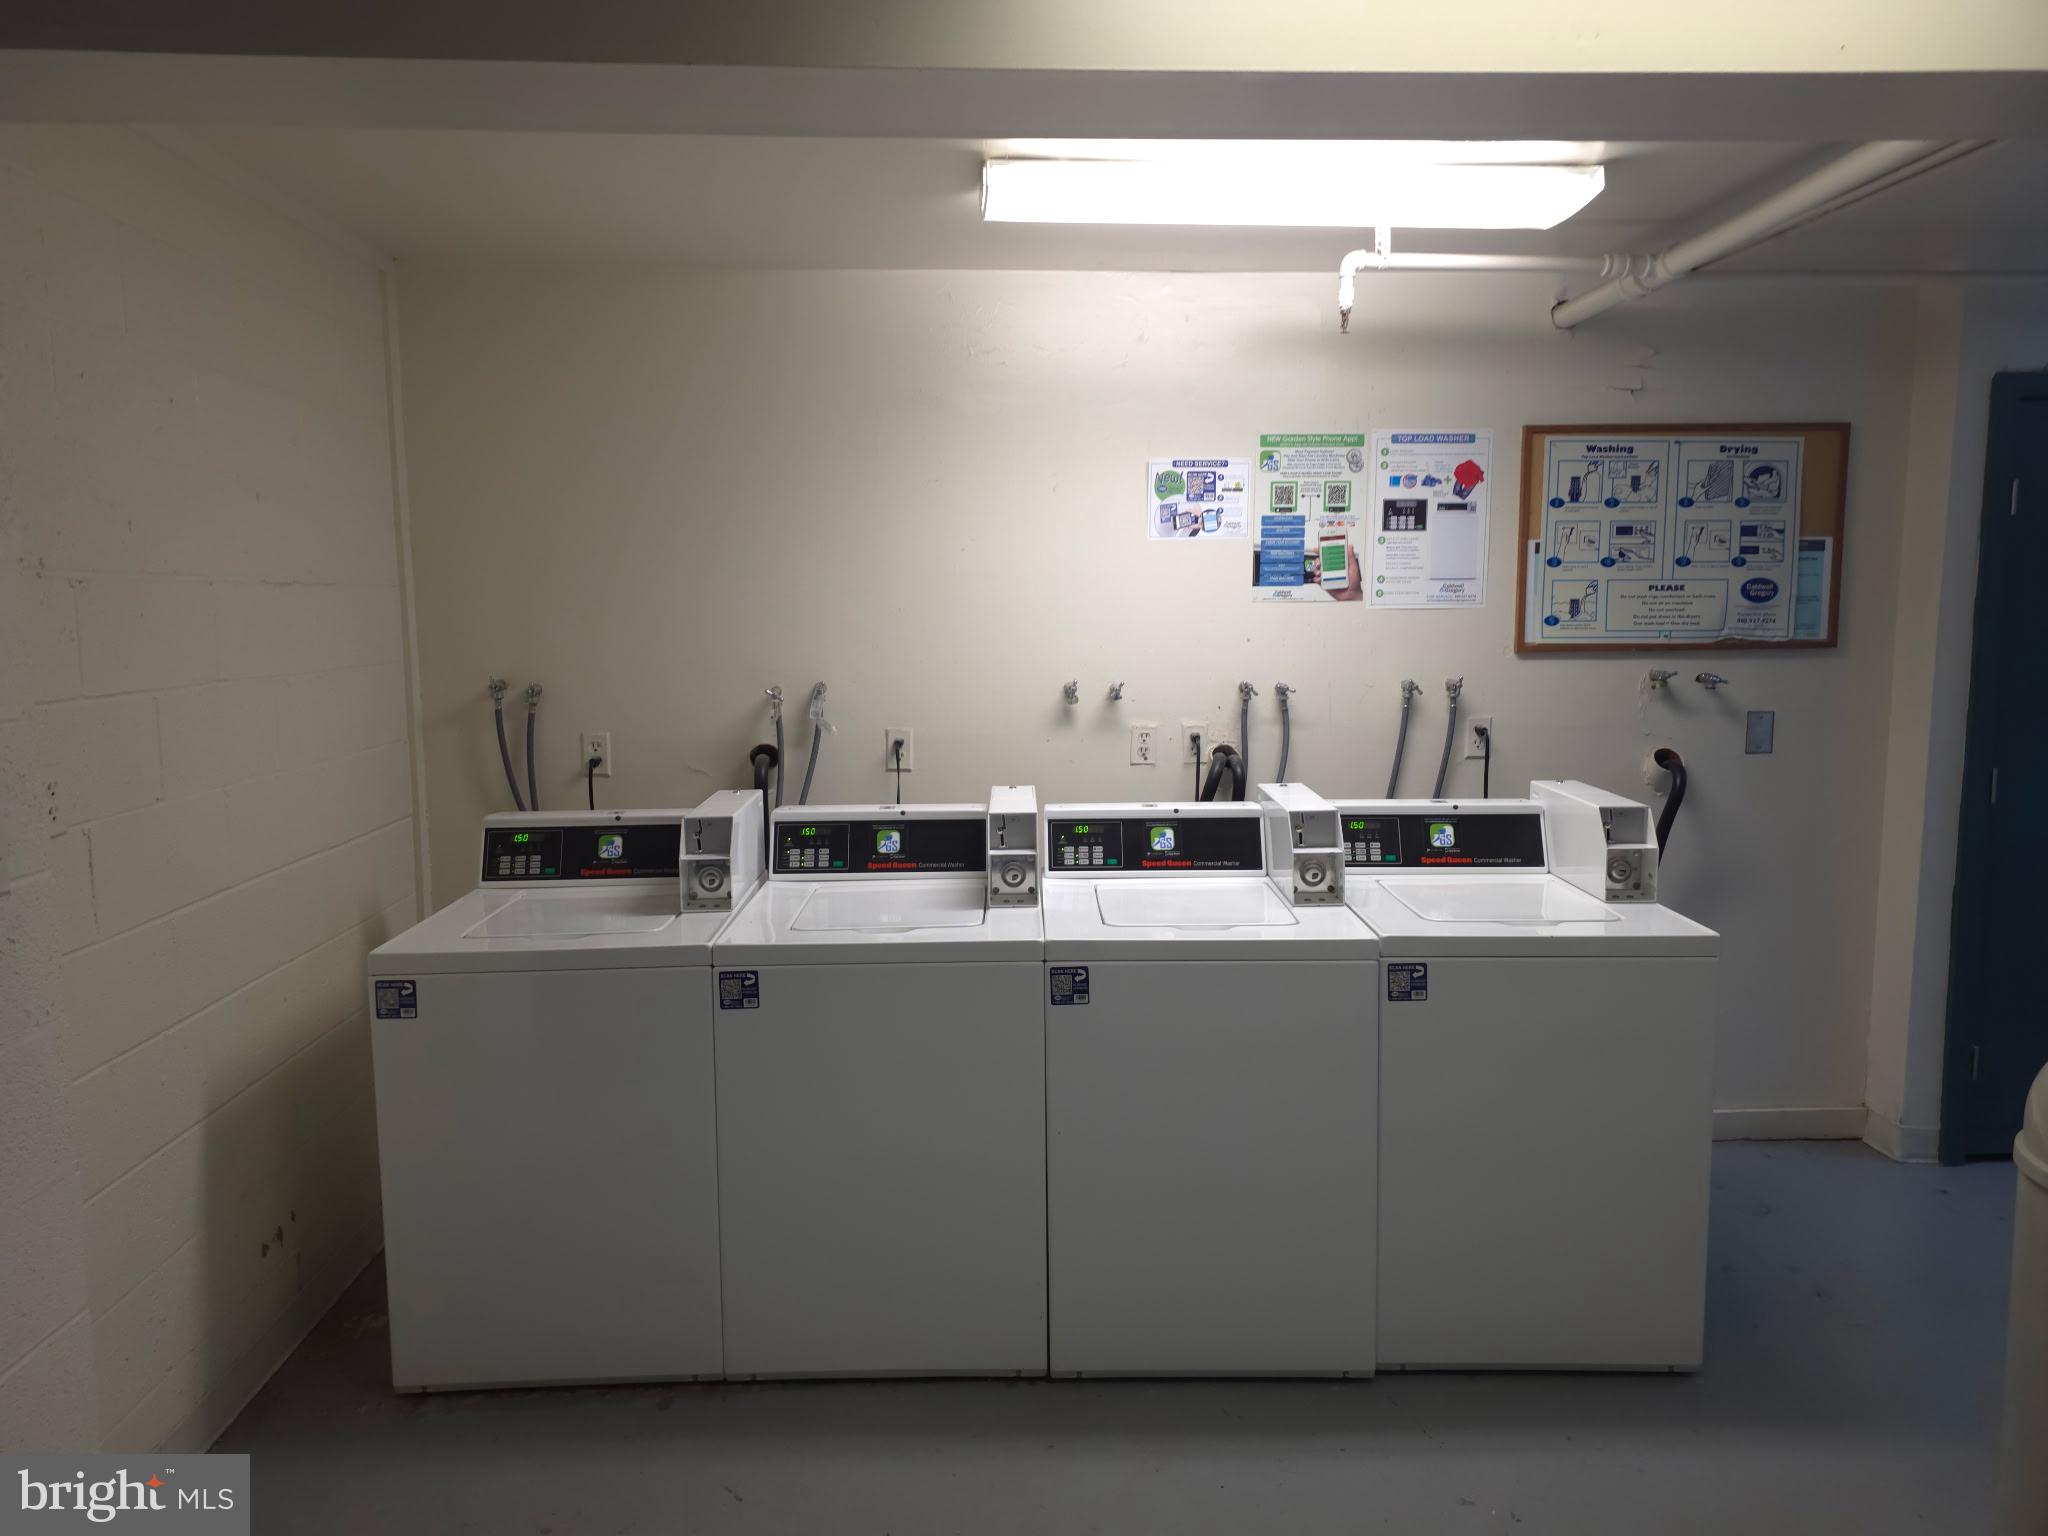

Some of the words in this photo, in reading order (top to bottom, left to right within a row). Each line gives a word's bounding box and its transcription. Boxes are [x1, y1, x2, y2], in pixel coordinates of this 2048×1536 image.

[1586, 444, 1634, 454] Washing
[1720, 445, 1759, 454] Drying
[1267, 460, 1279, 471] GS
[1155, 471, 1183, 485] New!
[1648, 584, 1685, 592] PLEASE
[1160, 837, 1173, 849] GS
[1439, 834, 1453, 846] GS
[607, 845, 620, 856] GS
[885, 840, 898, 852] GS
[580, 869, 605, 877] Speed
